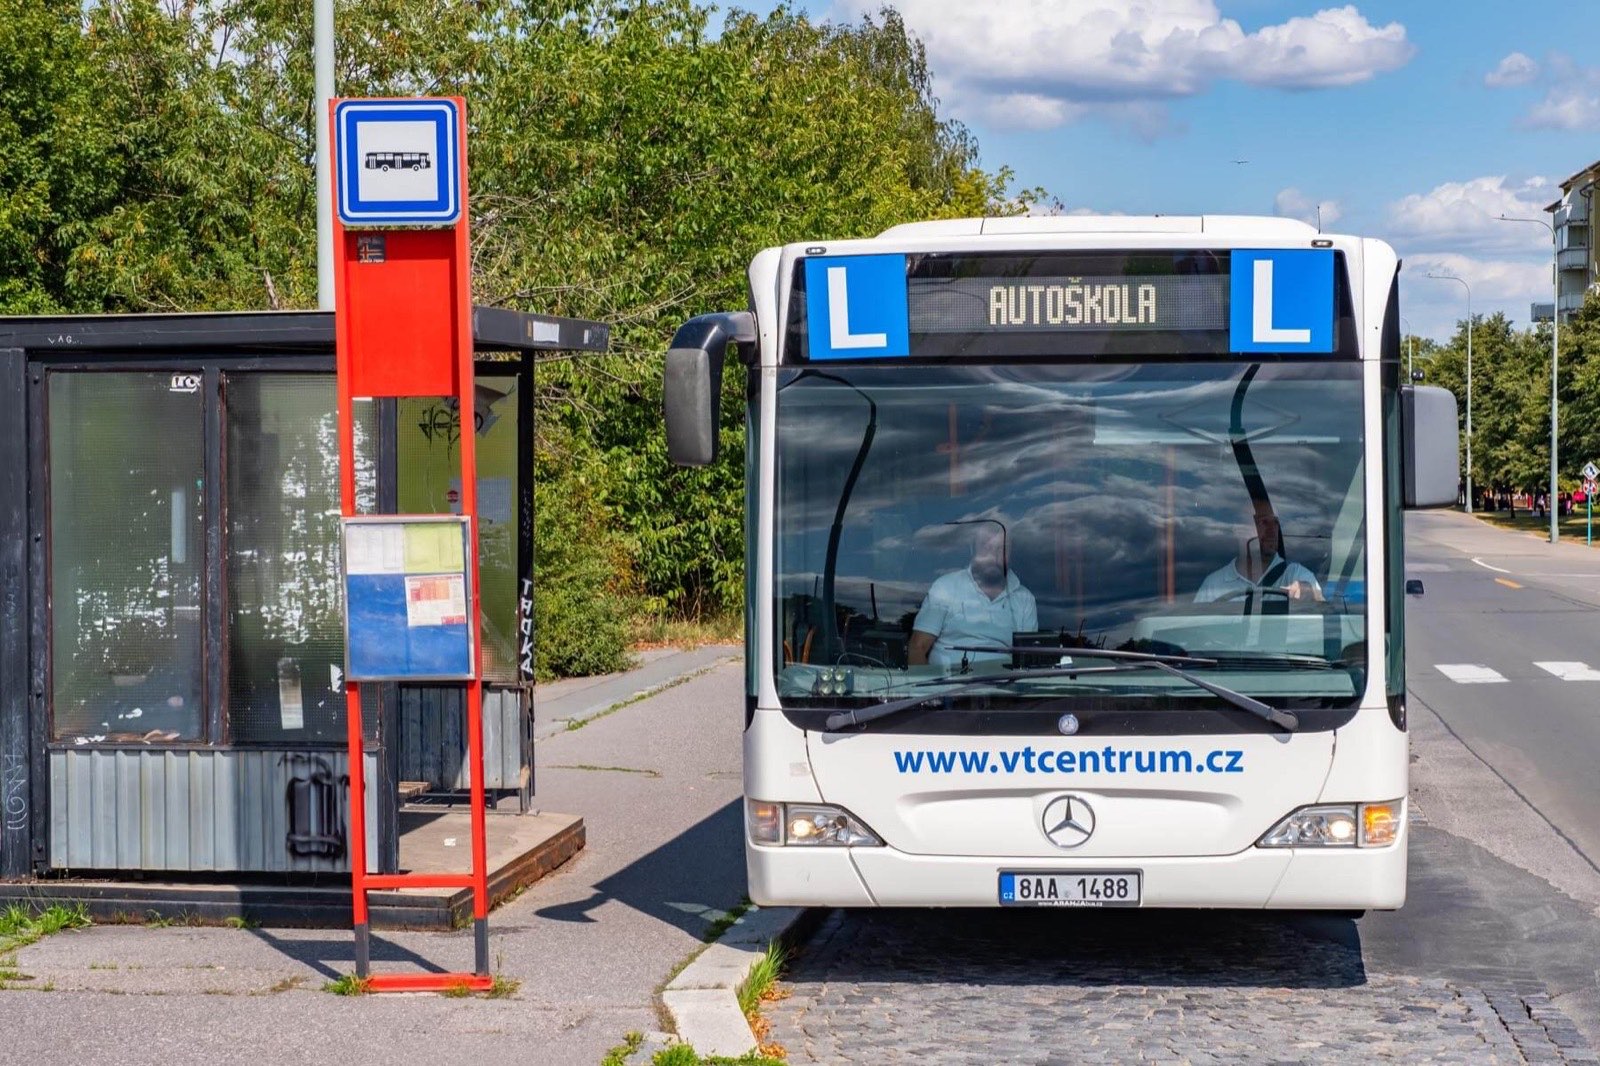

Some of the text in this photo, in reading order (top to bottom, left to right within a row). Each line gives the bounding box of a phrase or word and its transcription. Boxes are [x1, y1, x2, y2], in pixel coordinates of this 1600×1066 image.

[827, 266, 887, 350] L
[989, 277, 1156, 325] AUTOŠKOLA
[1252, 259, 1311, 343] L
[894, 746, 1244, 773] www.vtcentrum.cz
[1019, 878, 1059, 899] 8AA
[1077, 878, 1129, 899] 1488
